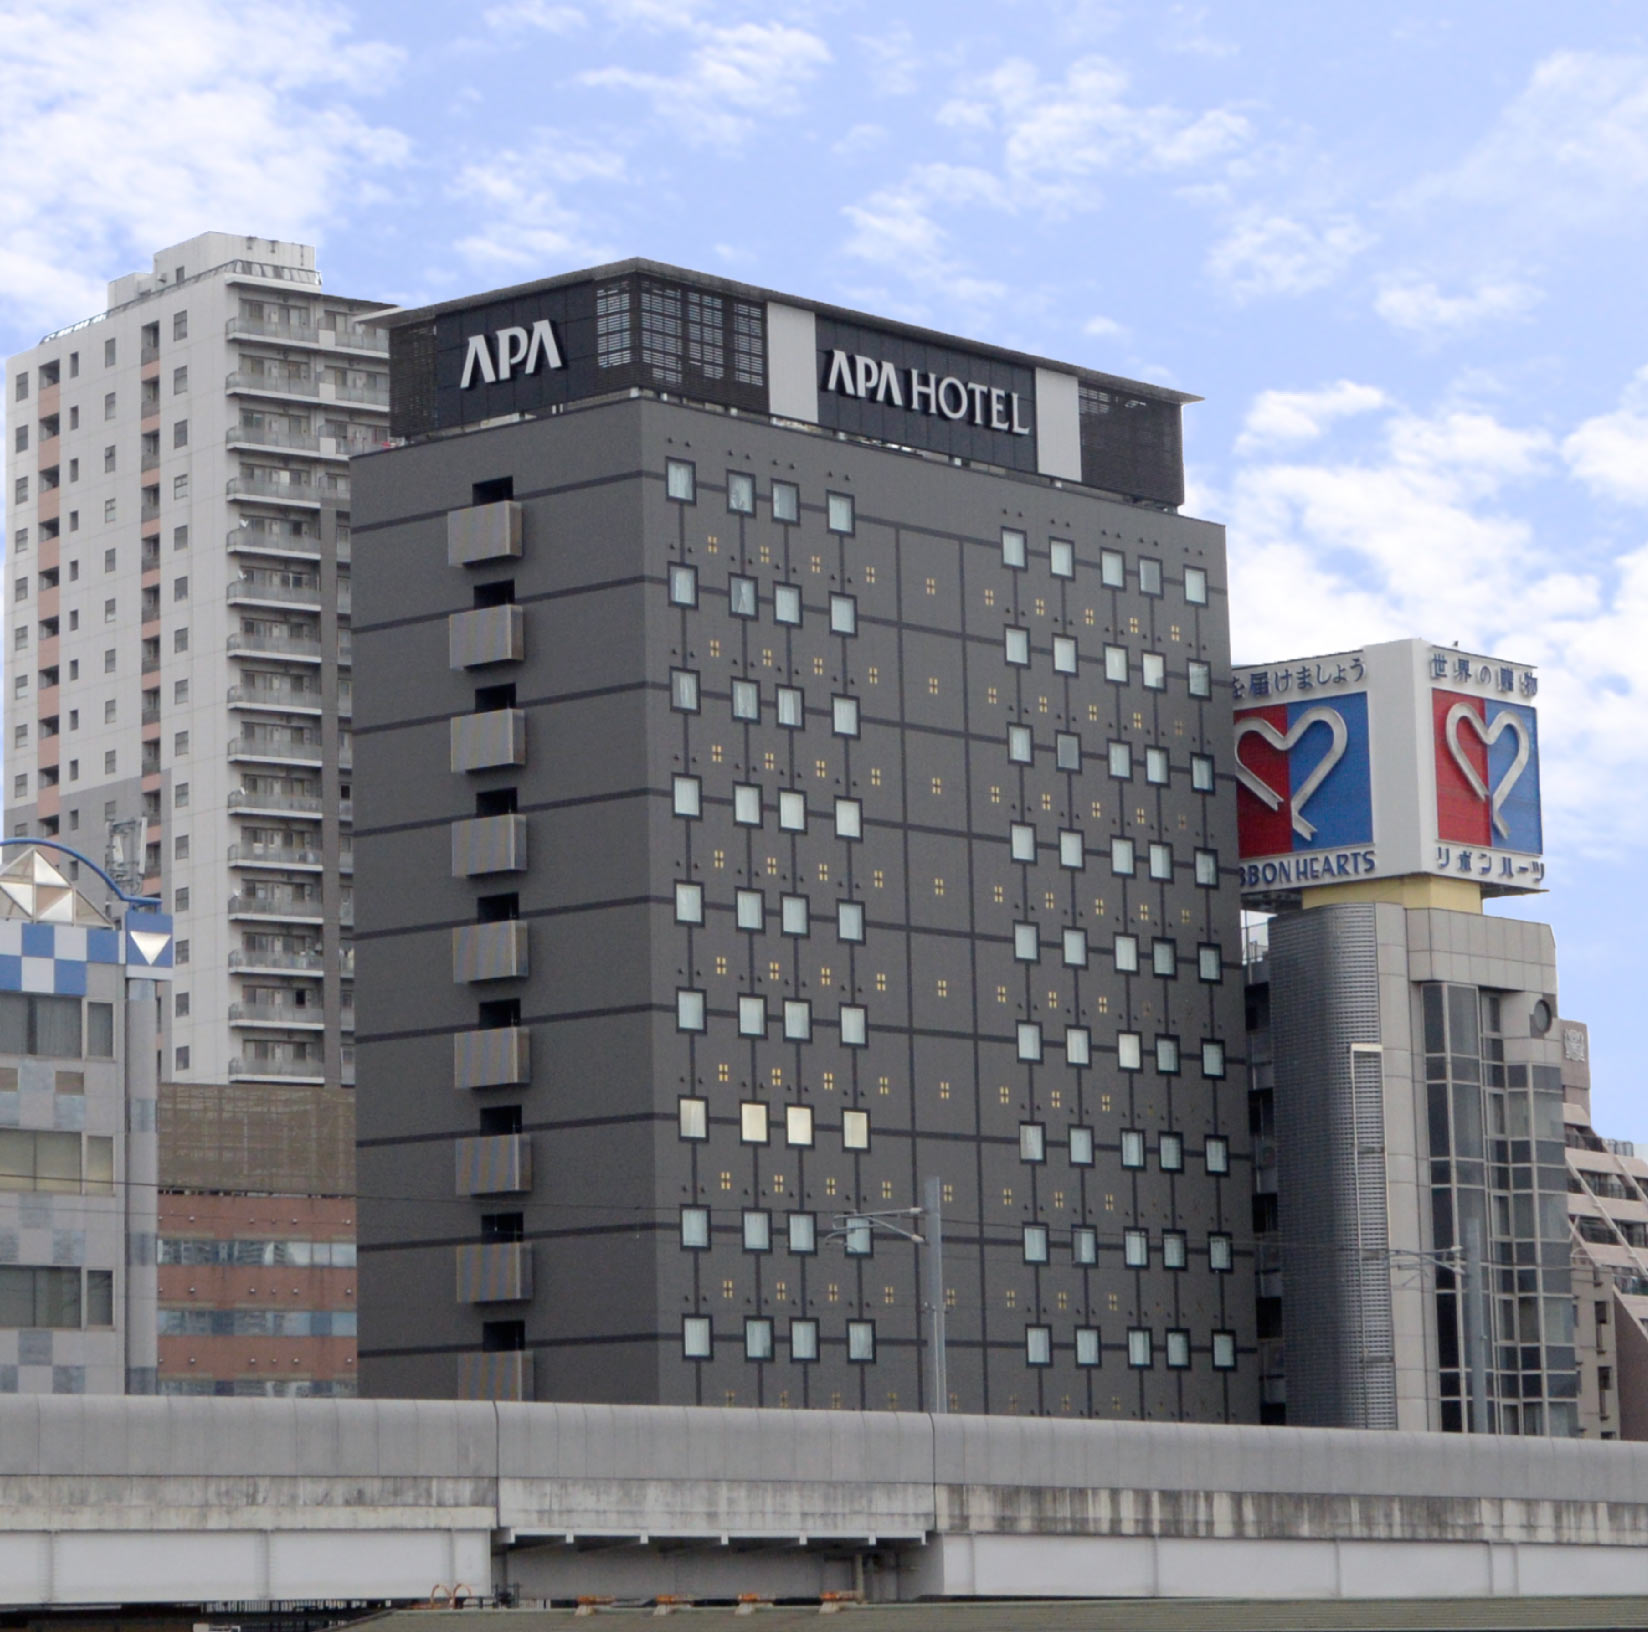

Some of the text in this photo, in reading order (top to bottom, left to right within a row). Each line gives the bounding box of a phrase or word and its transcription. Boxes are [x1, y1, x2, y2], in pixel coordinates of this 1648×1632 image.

[460, 319, 562, 389] APA
[828, 350, 1030, 435] APA HOTEL
[1296, 850, 1376, 881] HEARTS
